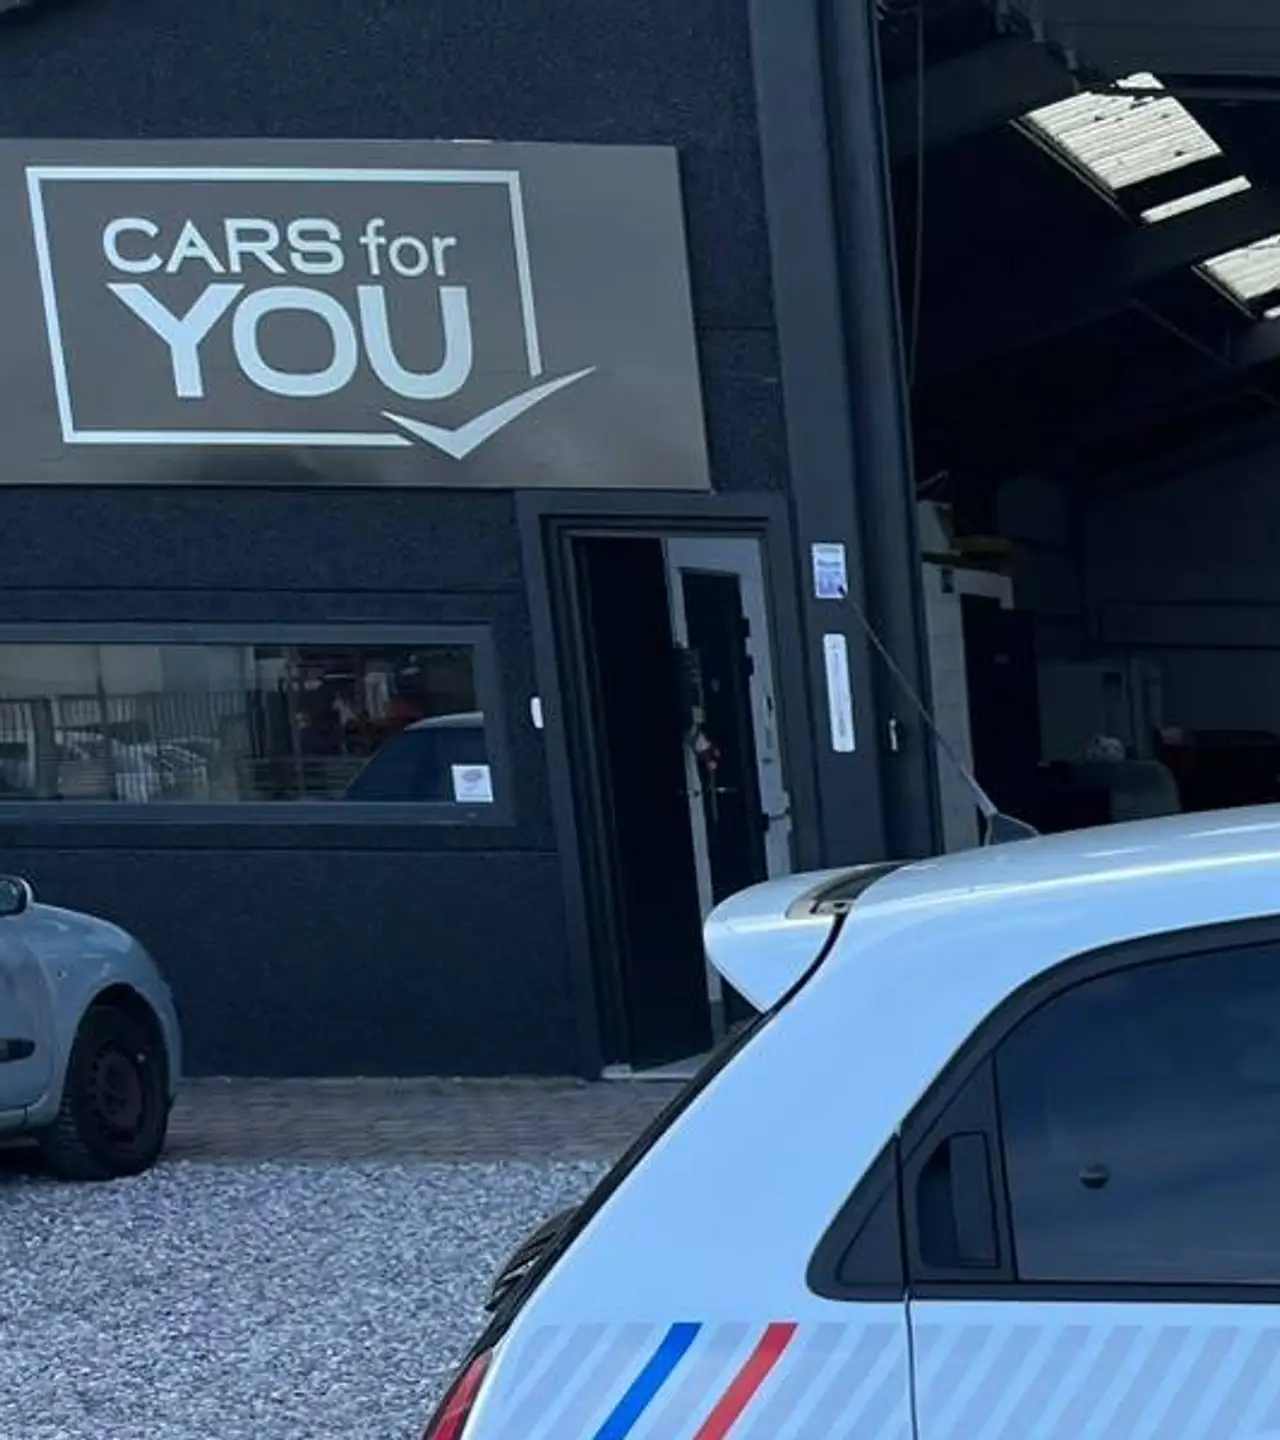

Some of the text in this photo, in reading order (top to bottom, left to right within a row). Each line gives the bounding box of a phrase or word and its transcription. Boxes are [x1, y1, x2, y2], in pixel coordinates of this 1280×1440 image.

[104, 218, 456, 276] CARS for
[107, 283, 471, 399] YOU
